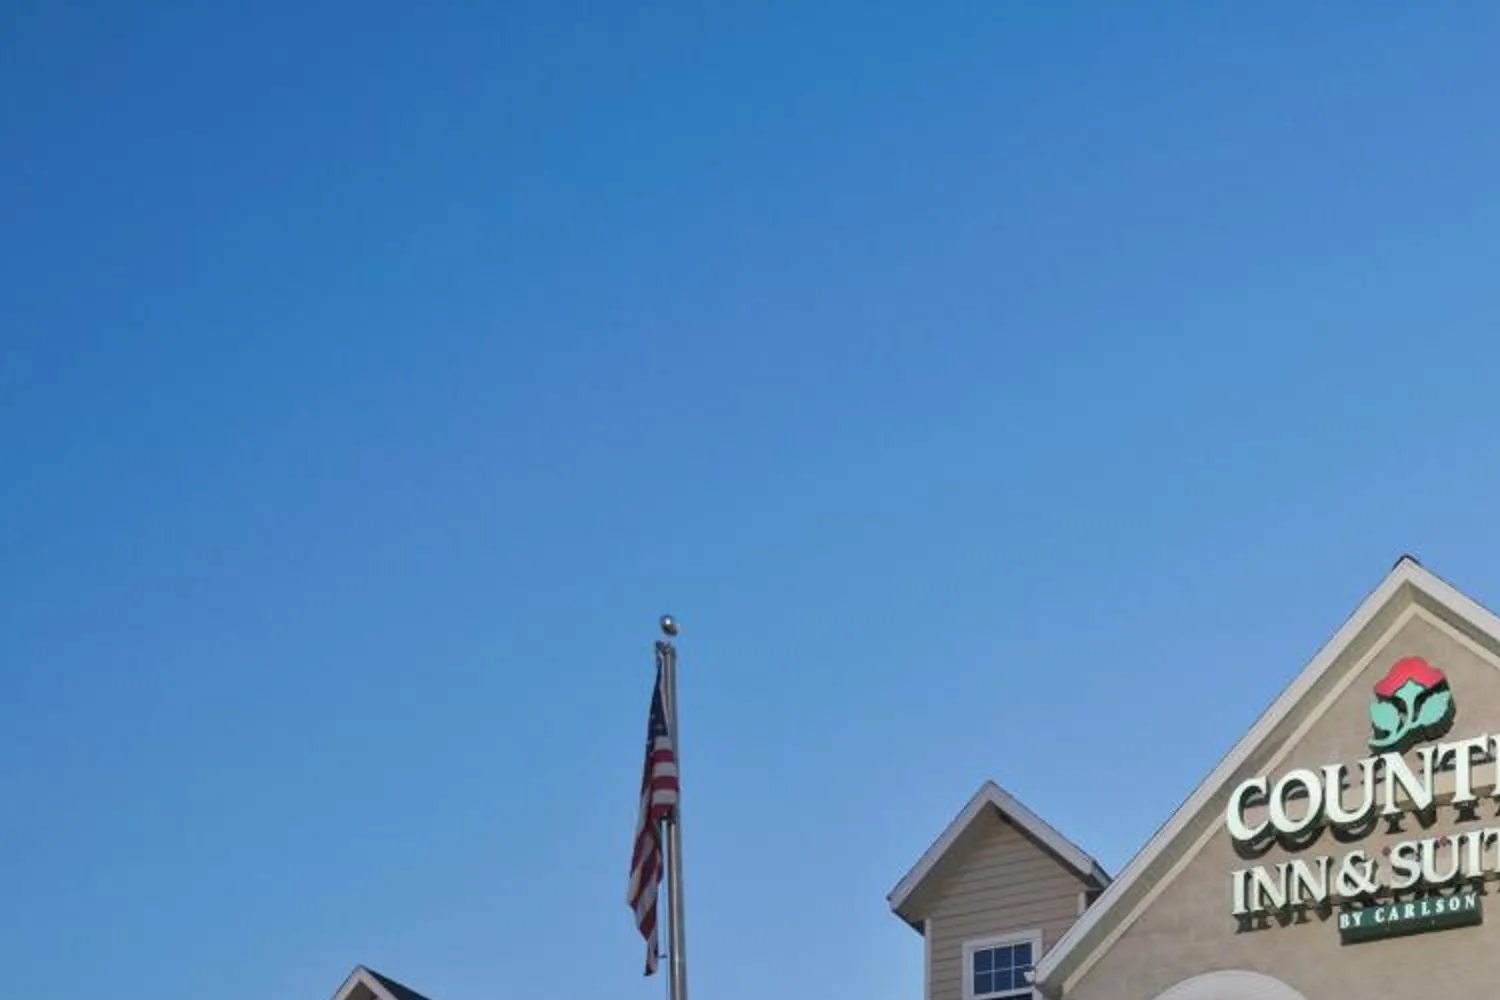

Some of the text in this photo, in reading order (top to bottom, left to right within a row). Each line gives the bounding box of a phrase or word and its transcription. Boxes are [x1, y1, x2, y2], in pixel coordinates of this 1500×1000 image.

[1231, 855, 1329, 915] INN
[1339, 891, 1477, 929] BY CARLSON
